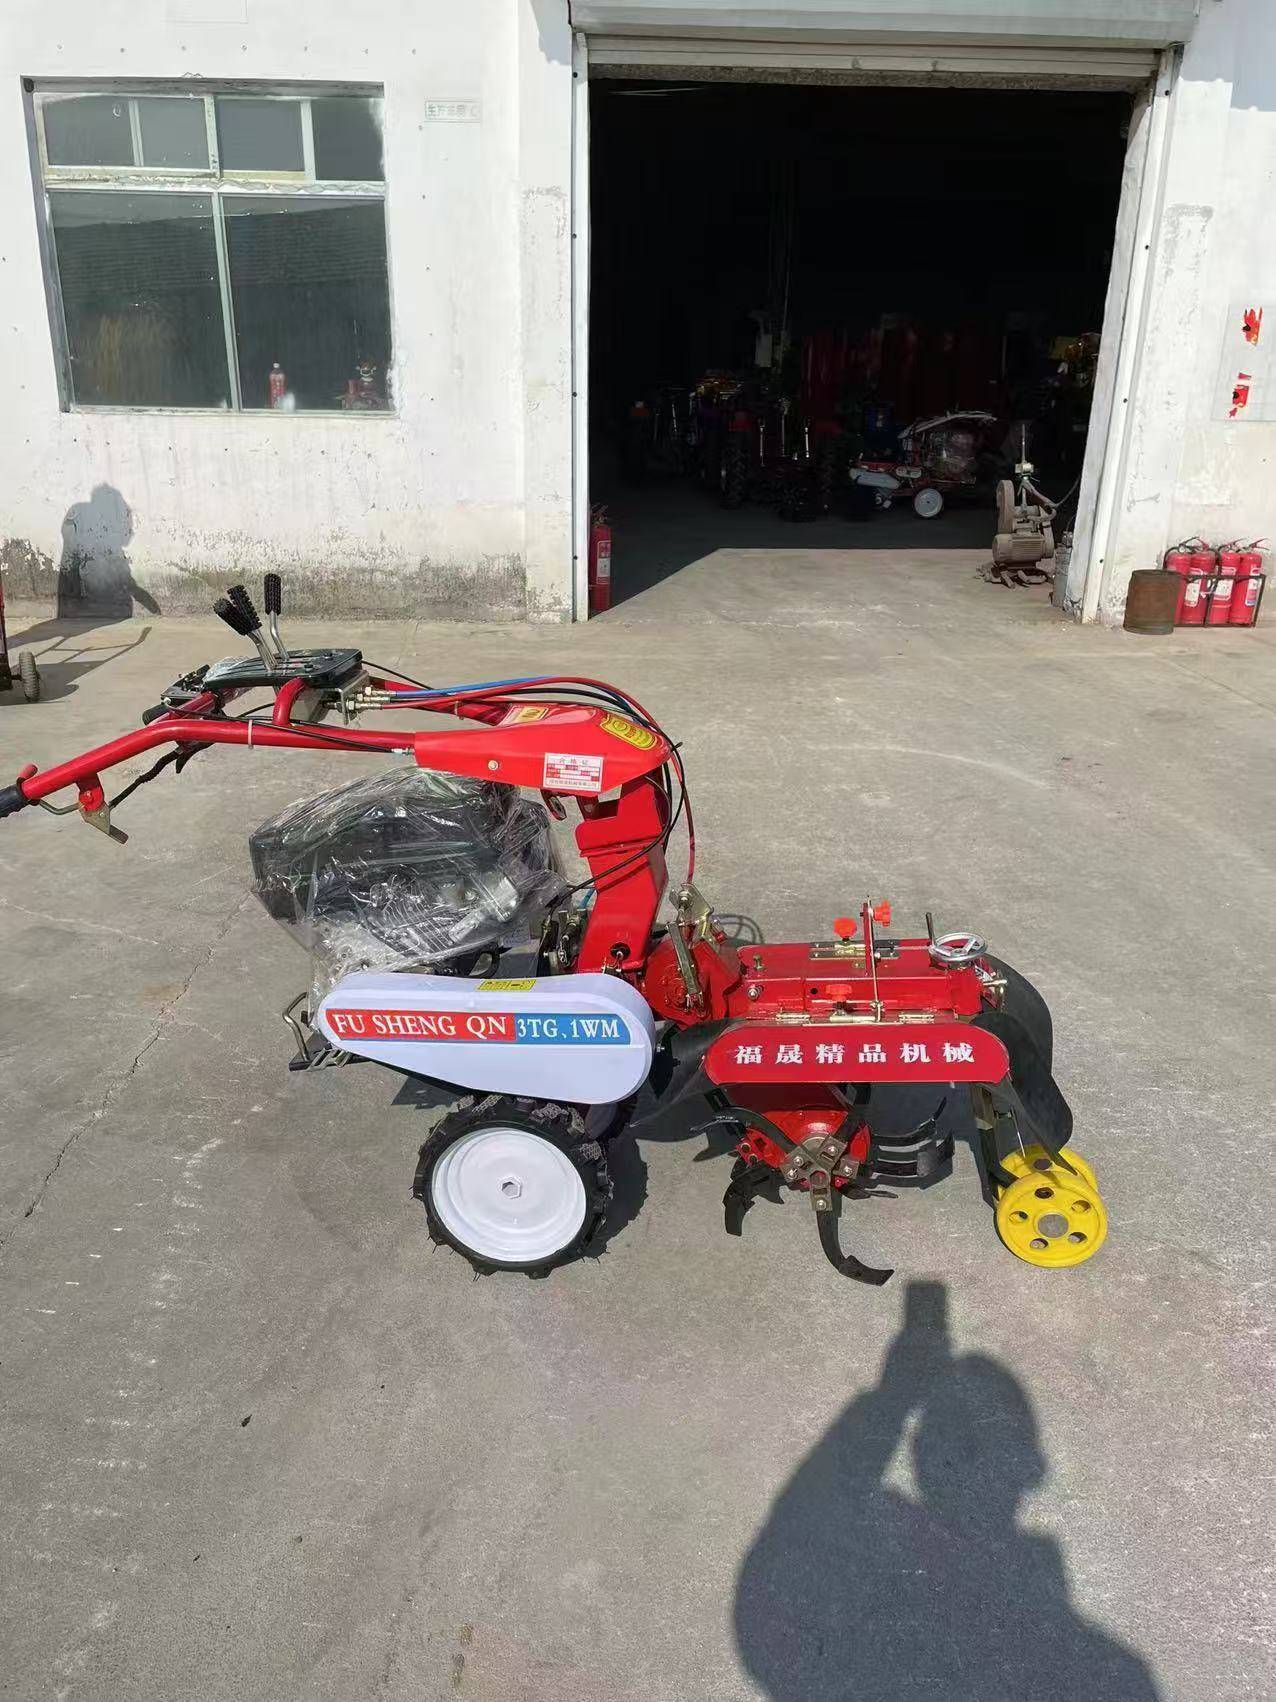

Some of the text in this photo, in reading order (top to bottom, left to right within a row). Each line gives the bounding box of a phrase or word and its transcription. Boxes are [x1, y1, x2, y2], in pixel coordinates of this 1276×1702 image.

[334, 1014, 364, 1034] FU
[372, 1015, 456, 1036] SHENG
[467, 1016, 507, 1039] QN
[734, 1043, 974, 1065] 福晟精品机械
